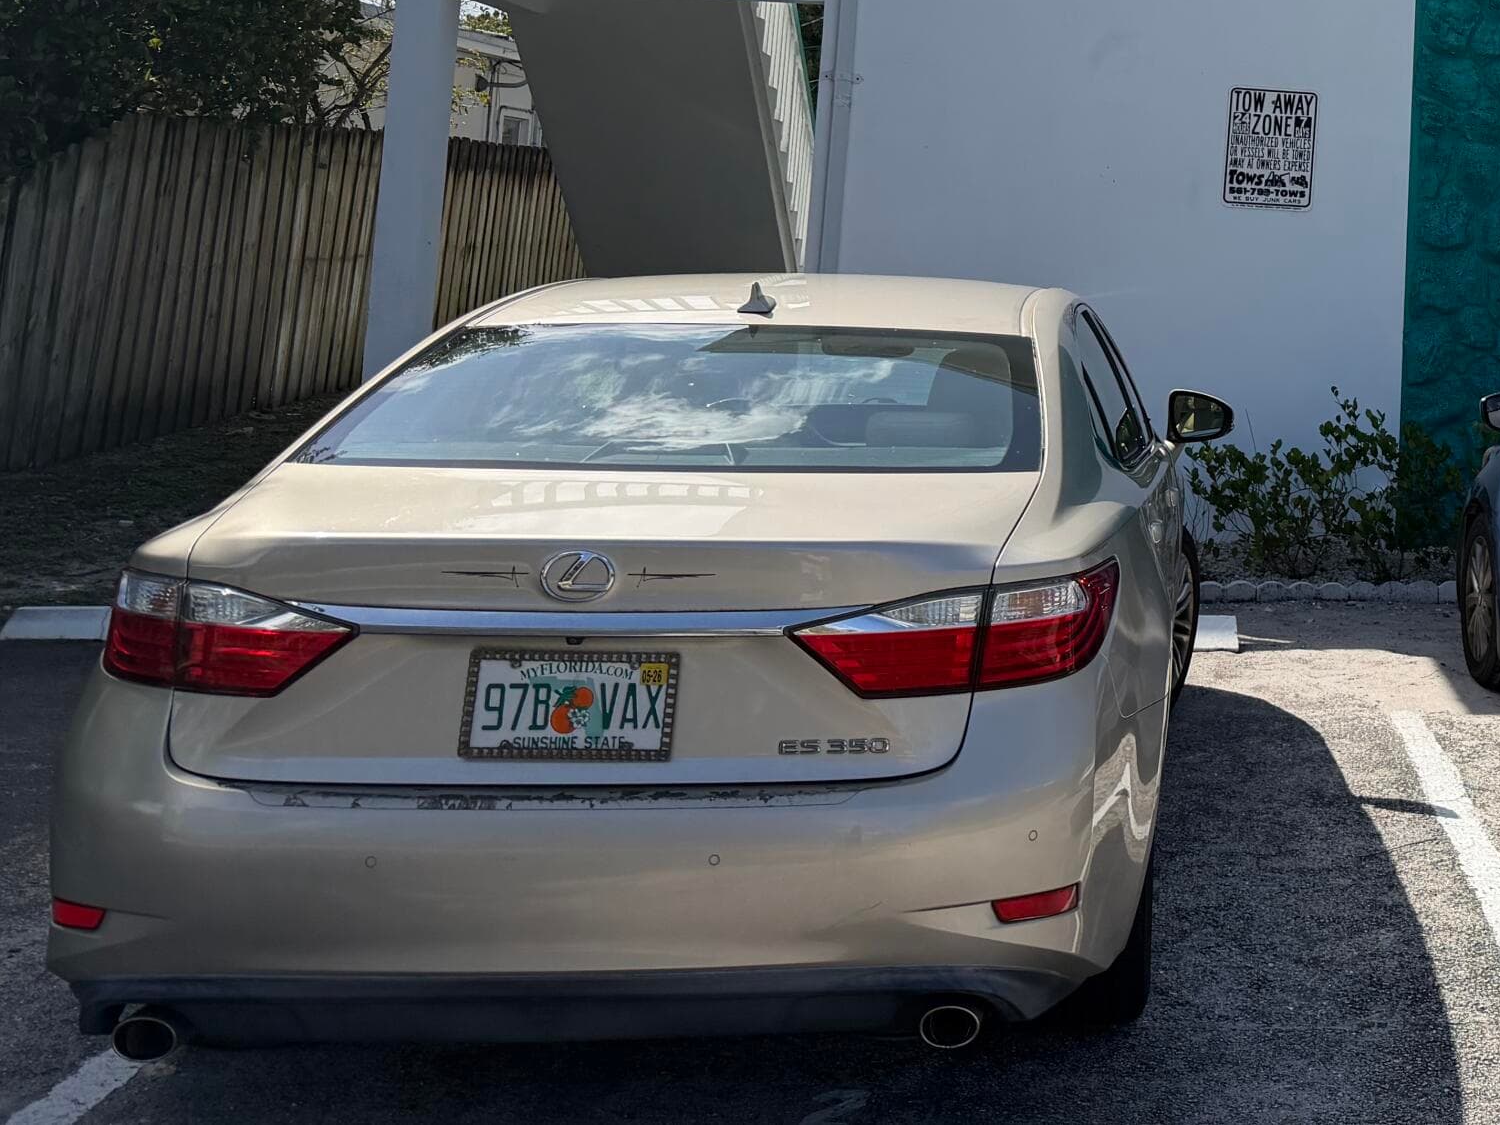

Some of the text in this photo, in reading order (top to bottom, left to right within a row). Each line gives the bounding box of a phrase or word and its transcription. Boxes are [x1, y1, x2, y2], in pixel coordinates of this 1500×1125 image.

[1234, 90, 1314, 116] TOW AWAY
[1234, 112, 1250, 123] 24
[1251, 113, 1293, 137] ZONE
[1230, 135, 1312, 150] UNAUTHORIZED VEHICLES
[1240, 146, 1265, 159] VESSELS
[1267, 147, 1280, 160] WILL
[1282, 148, 1289, 160] BE
[1292, 149, 1311, 162] TOWED
[1229, 157, 1311, 173] AWAY AT OWNERS EXPENSE
[520, 661, 635, 681] MYFLORIDA.COM
[641, 669, 663, 684] 05-26
[481, 683, 663, 731] 97B VAX
[513, 736, 625, 750] SUNSHINE STATE
[778, 737, 890, 755] ES 350
